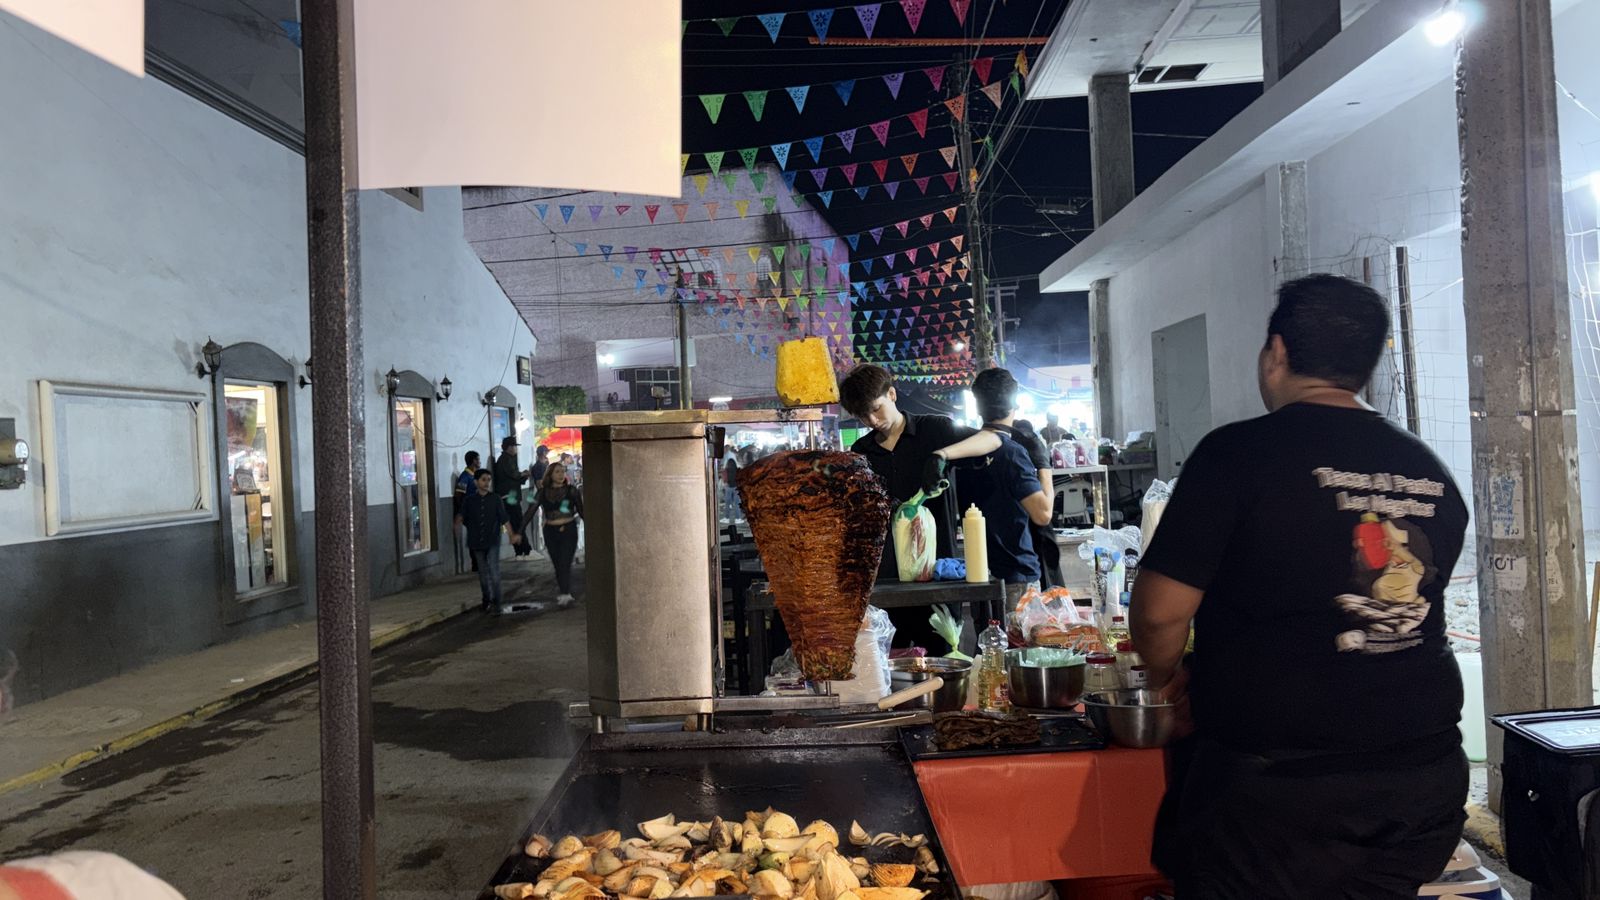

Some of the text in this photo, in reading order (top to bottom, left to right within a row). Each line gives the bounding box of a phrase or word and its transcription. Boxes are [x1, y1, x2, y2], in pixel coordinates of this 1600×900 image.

[1312, 467, 1444, 496] Tacos Al Pastor
[1336, 491, 1369, 511] Los
